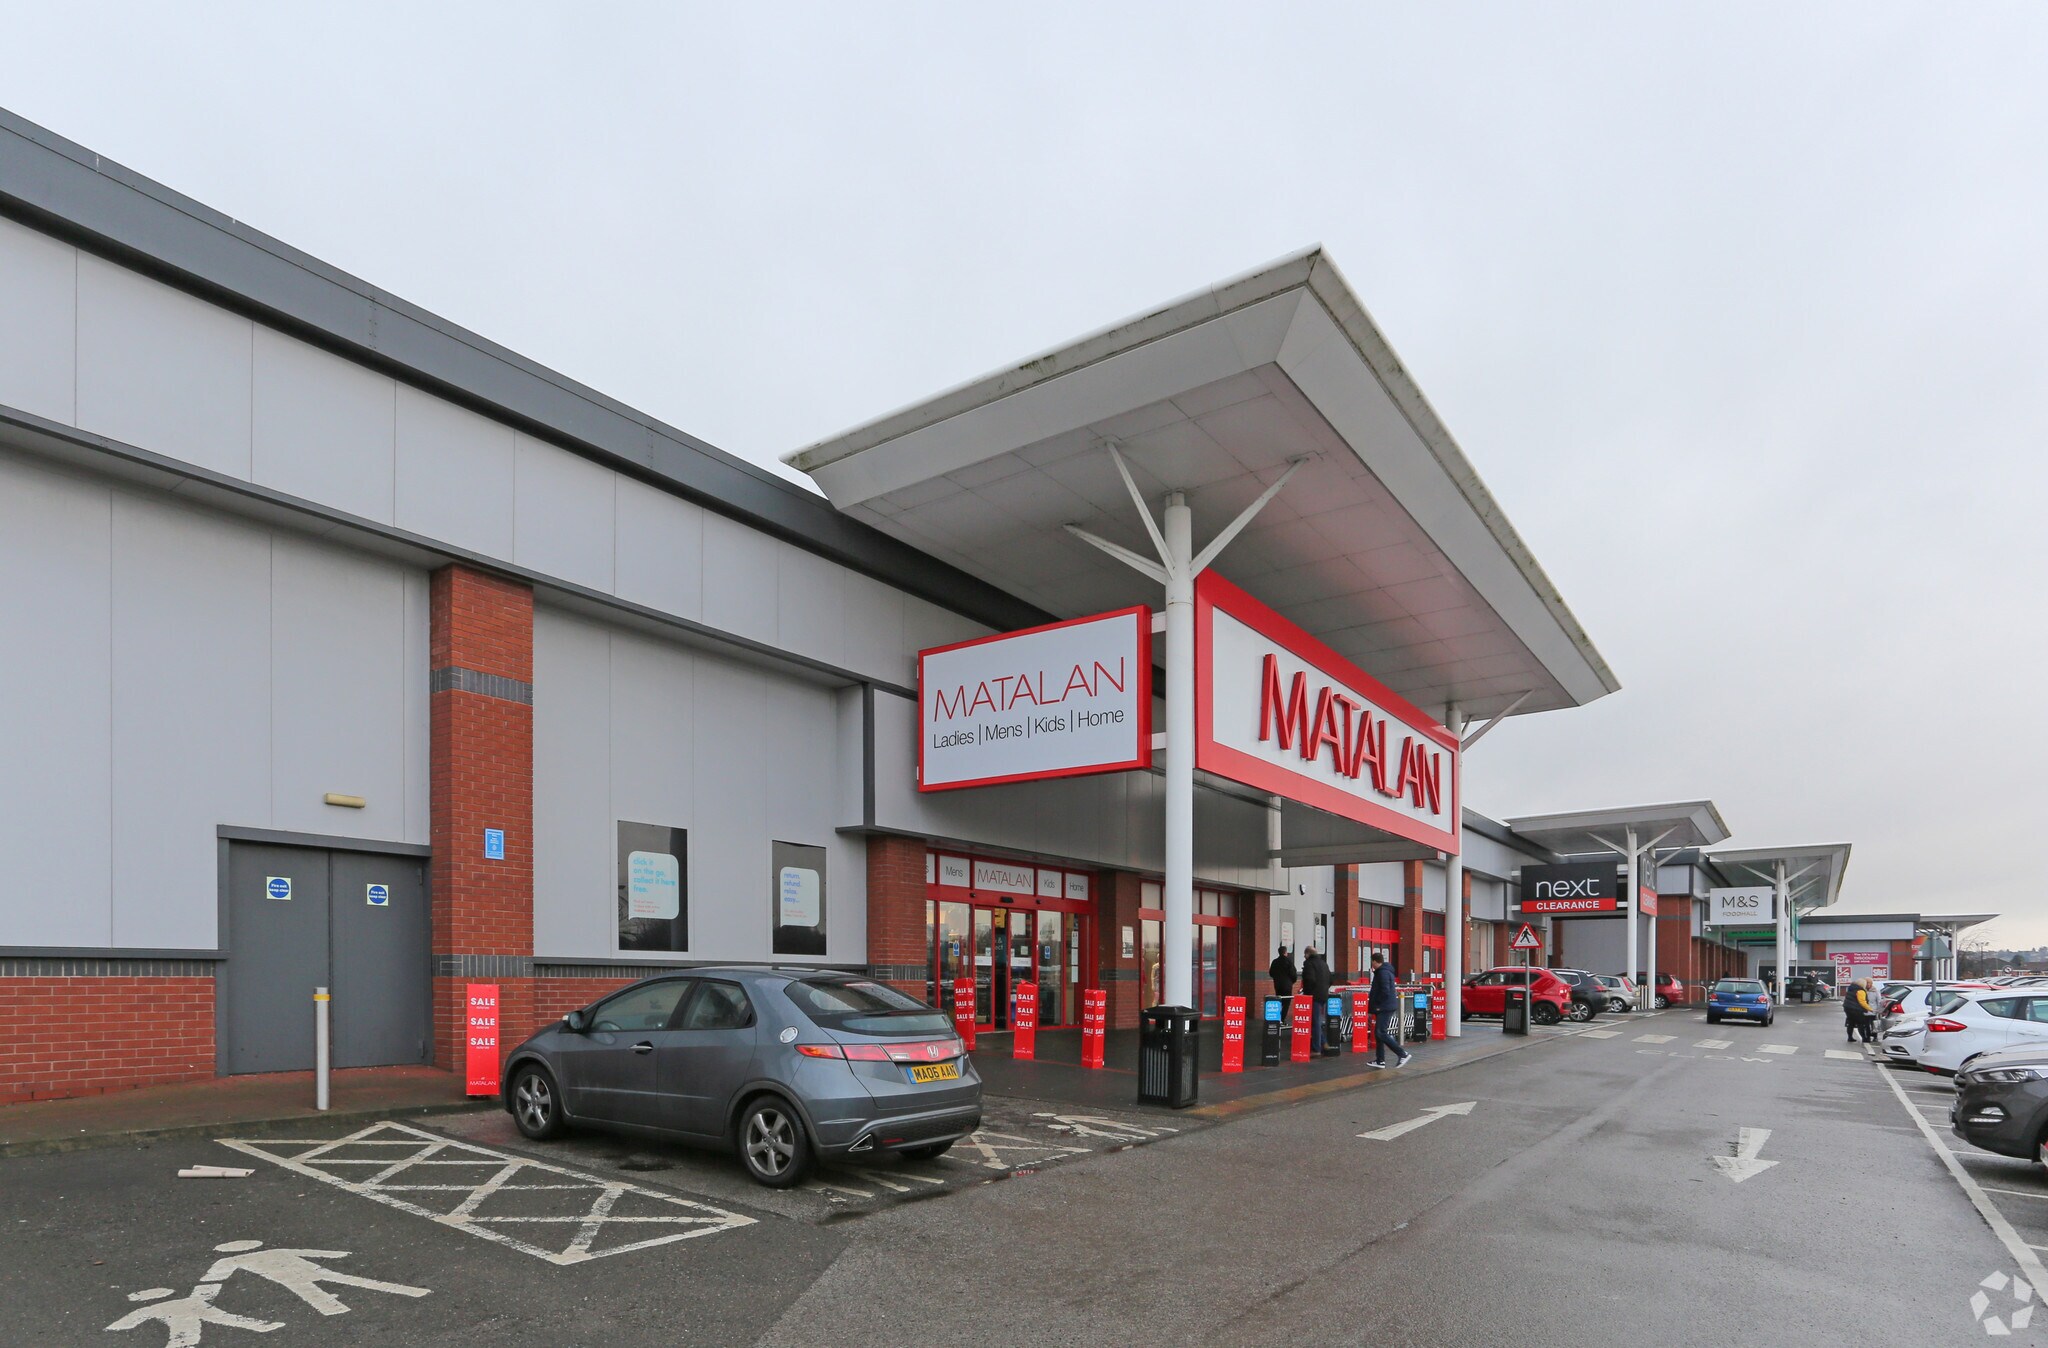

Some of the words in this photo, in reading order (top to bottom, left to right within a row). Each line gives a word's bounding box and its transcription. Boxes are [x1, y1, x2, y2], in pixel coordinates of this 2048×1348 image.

[934, 656, 1125, 722] MATALAN
[933, 730, 975, 749] Ladies
[985, 723, 1023, 741] Mens
[1034, 716, 1066, 734] Kids
[1077, 709, 1125, 728] Home
[1259, 653, 1441, 816] MATALAN
[945, 865, 963, 878] Mens
[977, 868, 1032, 888] MATALAN
[1043, 878, 1055, 889] Kids
[1069, 882, 1084, 893] Home
[1536, 878, 1600, 898] next
[1536, 900, 1600, 910] CLEARANCE
[1722, 895, 1759, 909] M&S
[470, 998, 496, 1006] SALE
[470, 1018, 496, 1026] SALE
[470, 1038, 496, 1046] SALE
[914, 1066, 940, 1080] MA06
[940, 1065, 957, 1078] AAN
